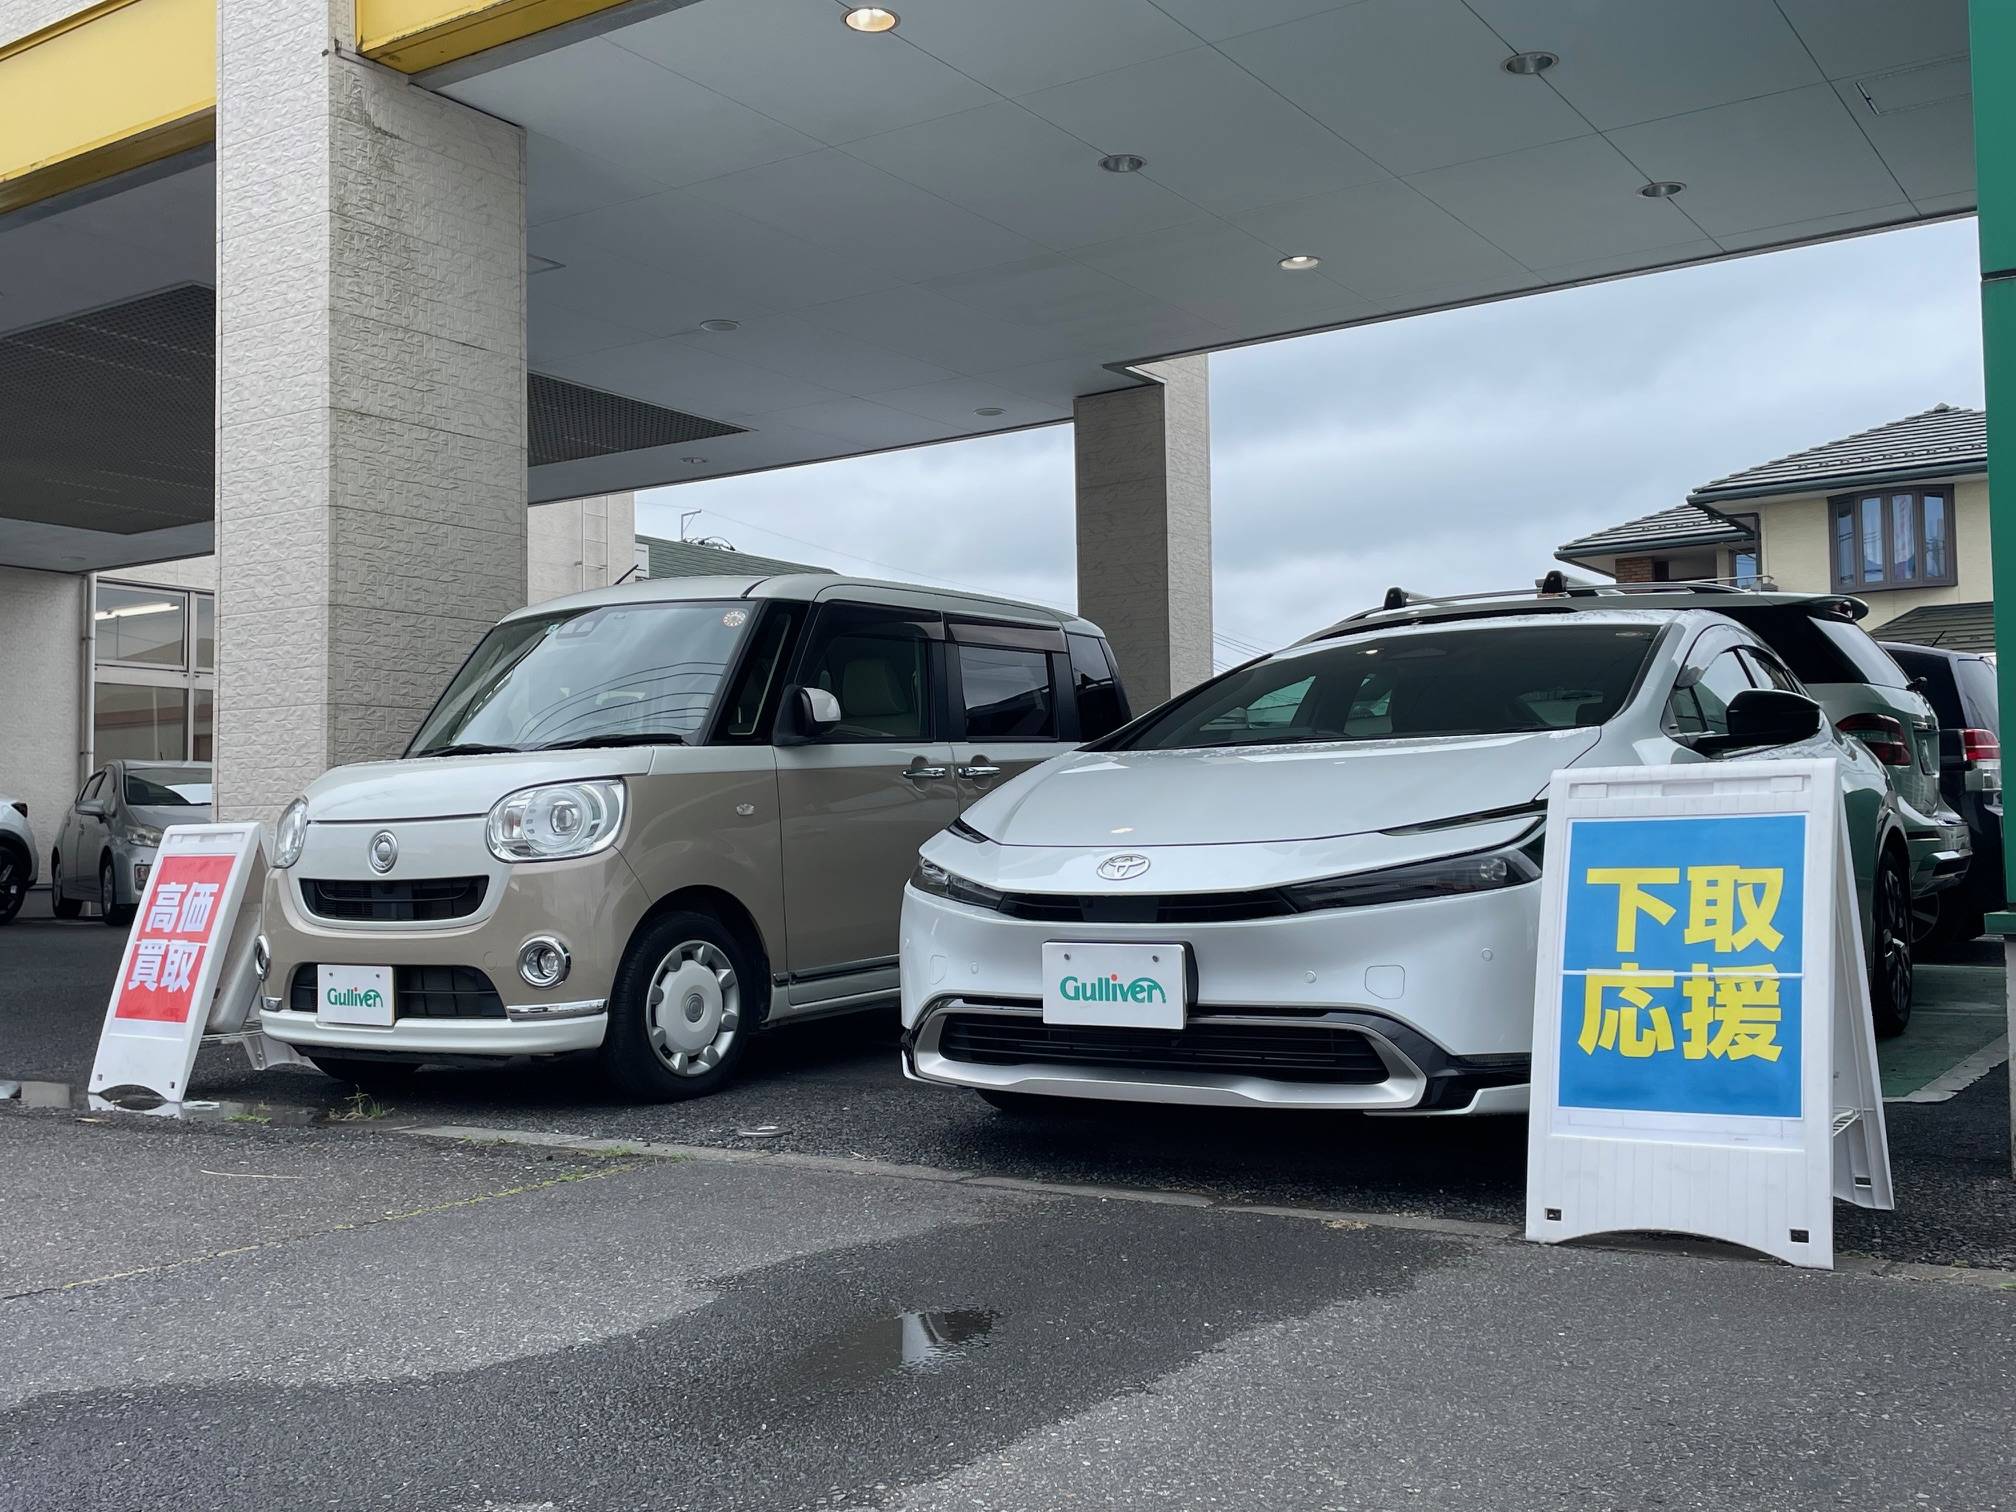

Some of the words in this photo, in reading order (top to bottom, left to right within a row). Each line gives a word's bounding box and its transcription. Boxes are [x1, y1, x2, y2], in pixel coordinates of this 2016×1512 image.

[145, 882, 219, 933] 高価
[1586, 865, 1784, 953] 下取
[128, 939, 200, 992] 買取
[1060, 974, 1166, 1003] Gulliver
[327, 987, 383, 1008] Gulliver
[1577, 962, 1783, 1062] 応援
